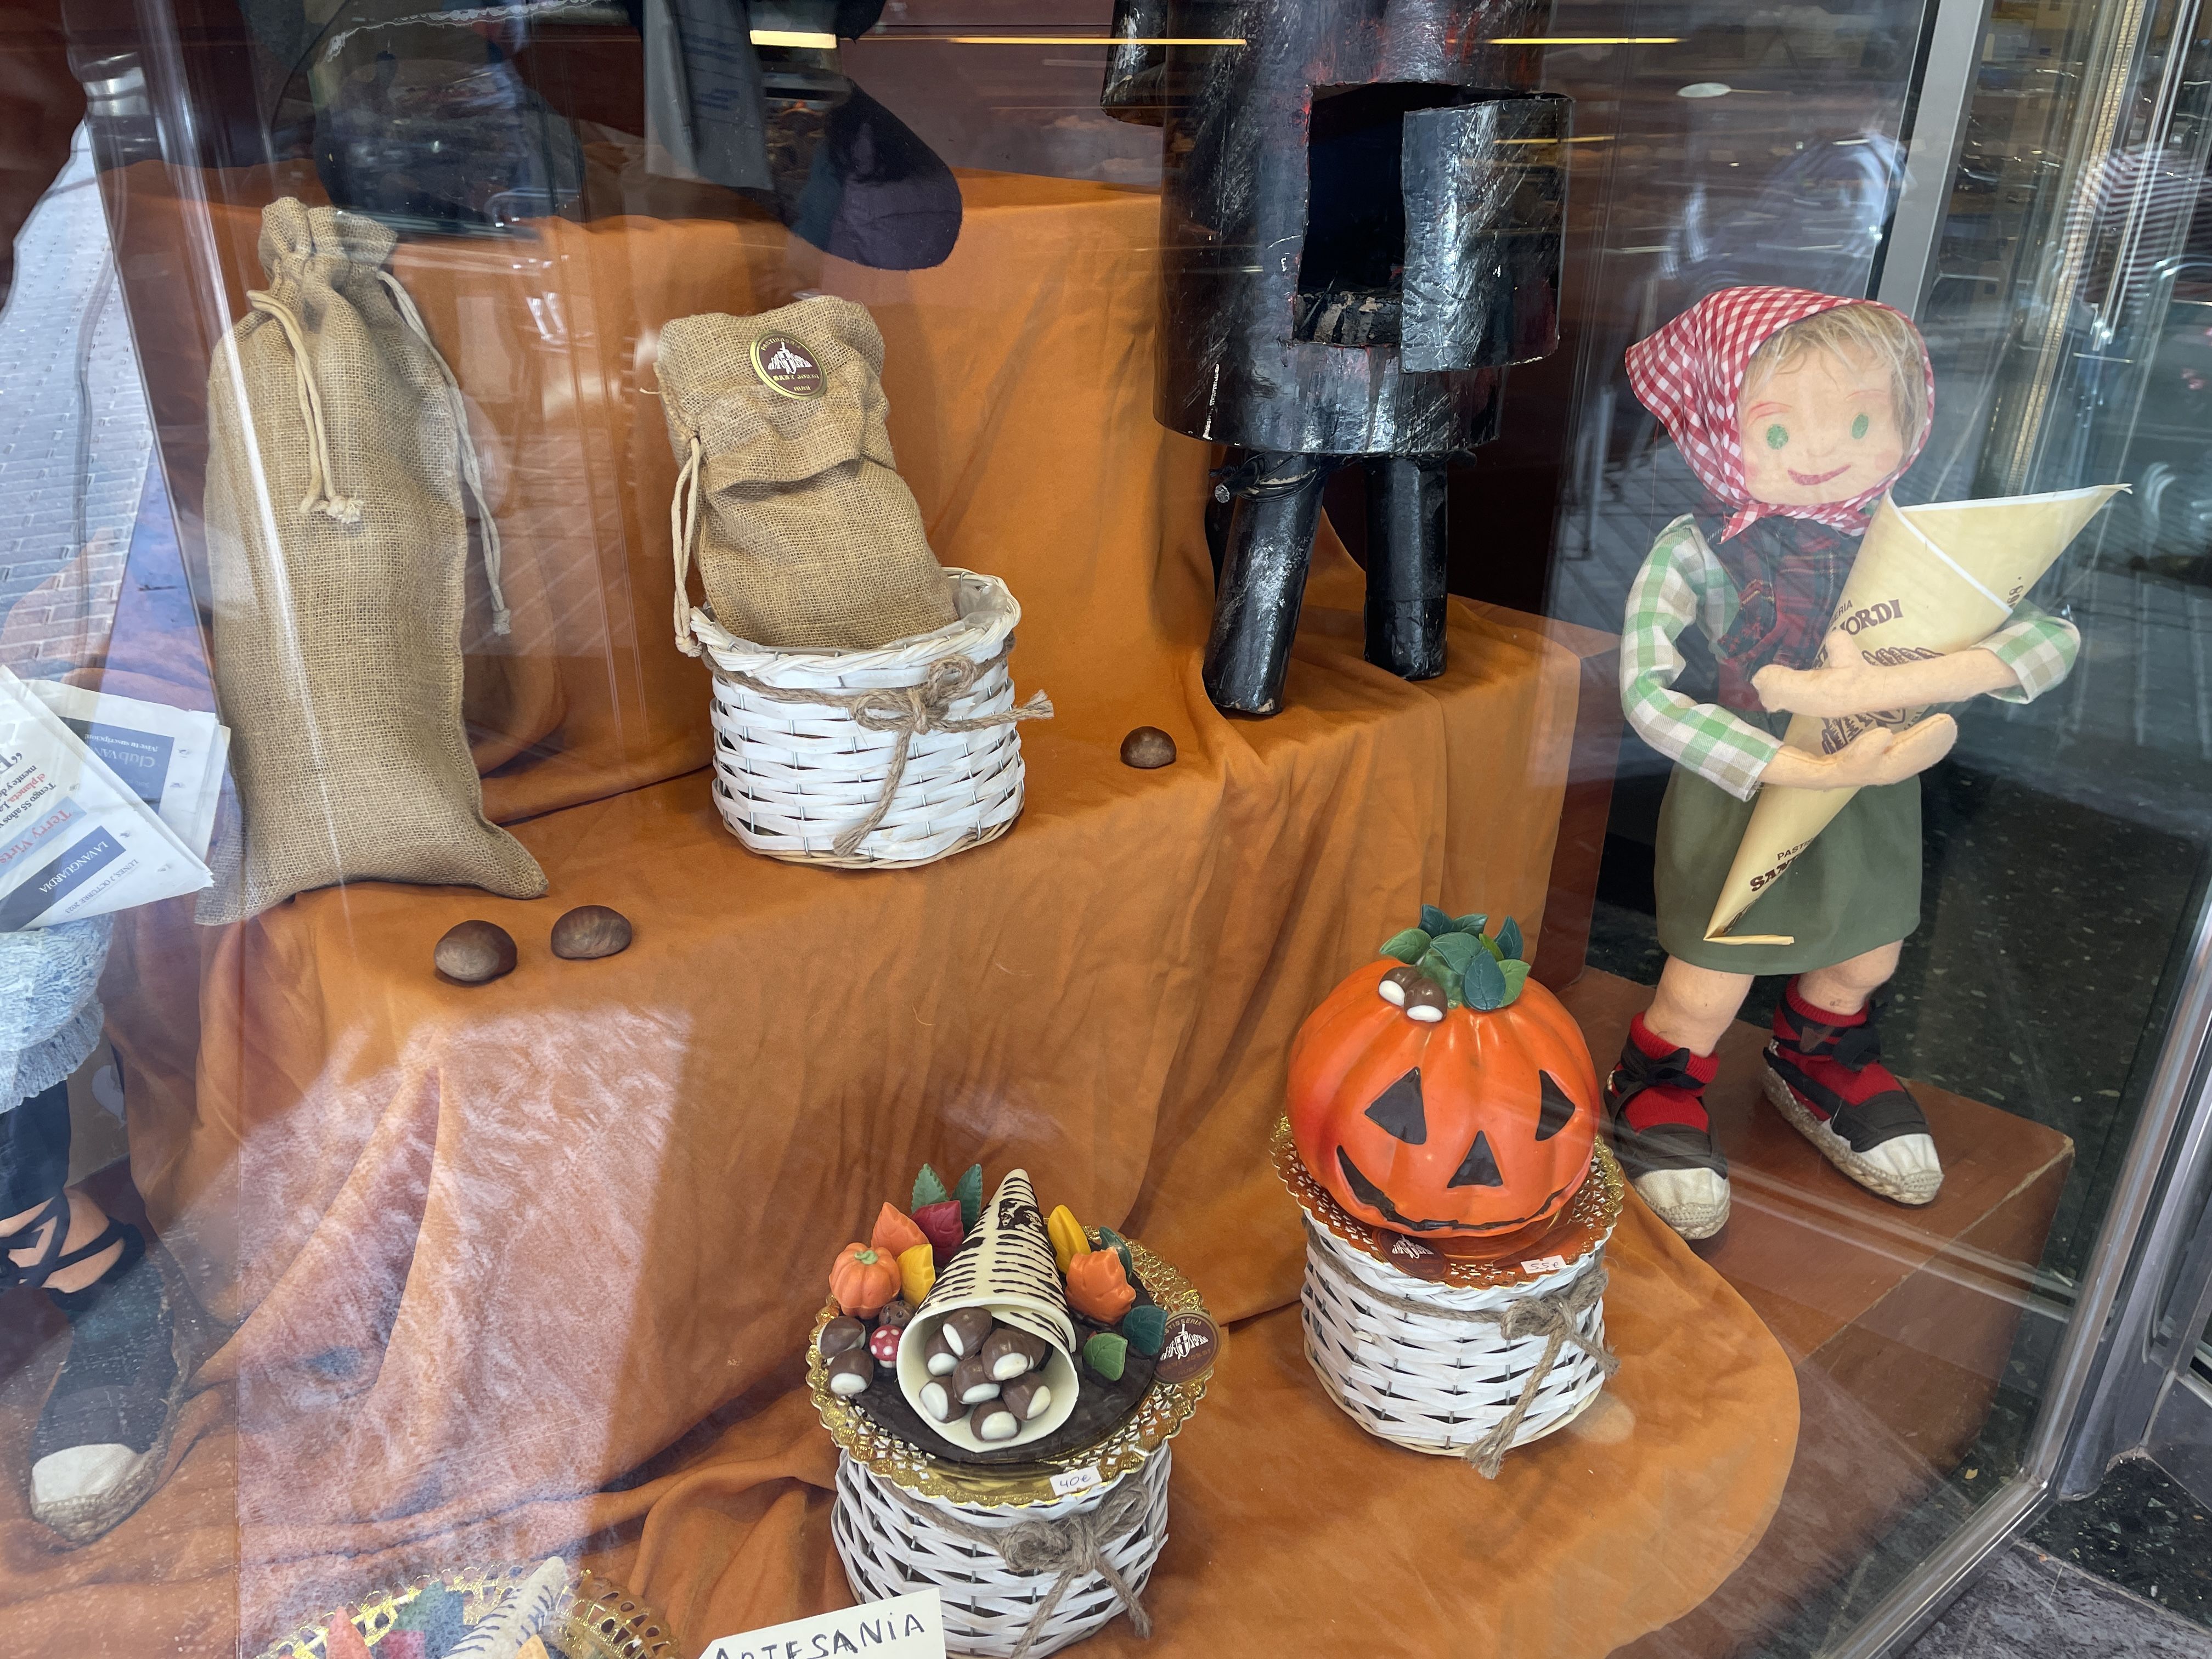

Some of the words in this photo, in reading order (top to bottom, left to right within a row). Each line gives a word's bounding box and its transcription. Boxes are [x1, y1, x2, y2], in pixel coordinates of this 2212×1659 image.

[13, 765, 37, 786] mente
[37, 773, 45, 782] el
[8, 777, 39, 803] planeta.
[30, 782, 57, 802] Tengo
[20, 800, 32, 811] 55
[2, 809, 21, 824] años
[31, 809, 72, 839] Terry
[0, 840, 34, 864] Virts
[93, 840, 109, 853] LA
[39, 850, 98, 894] VANGUARDIA
[81, 879, 111, 904] OCTUBRE
[65, 901, 81, 914] 2023
